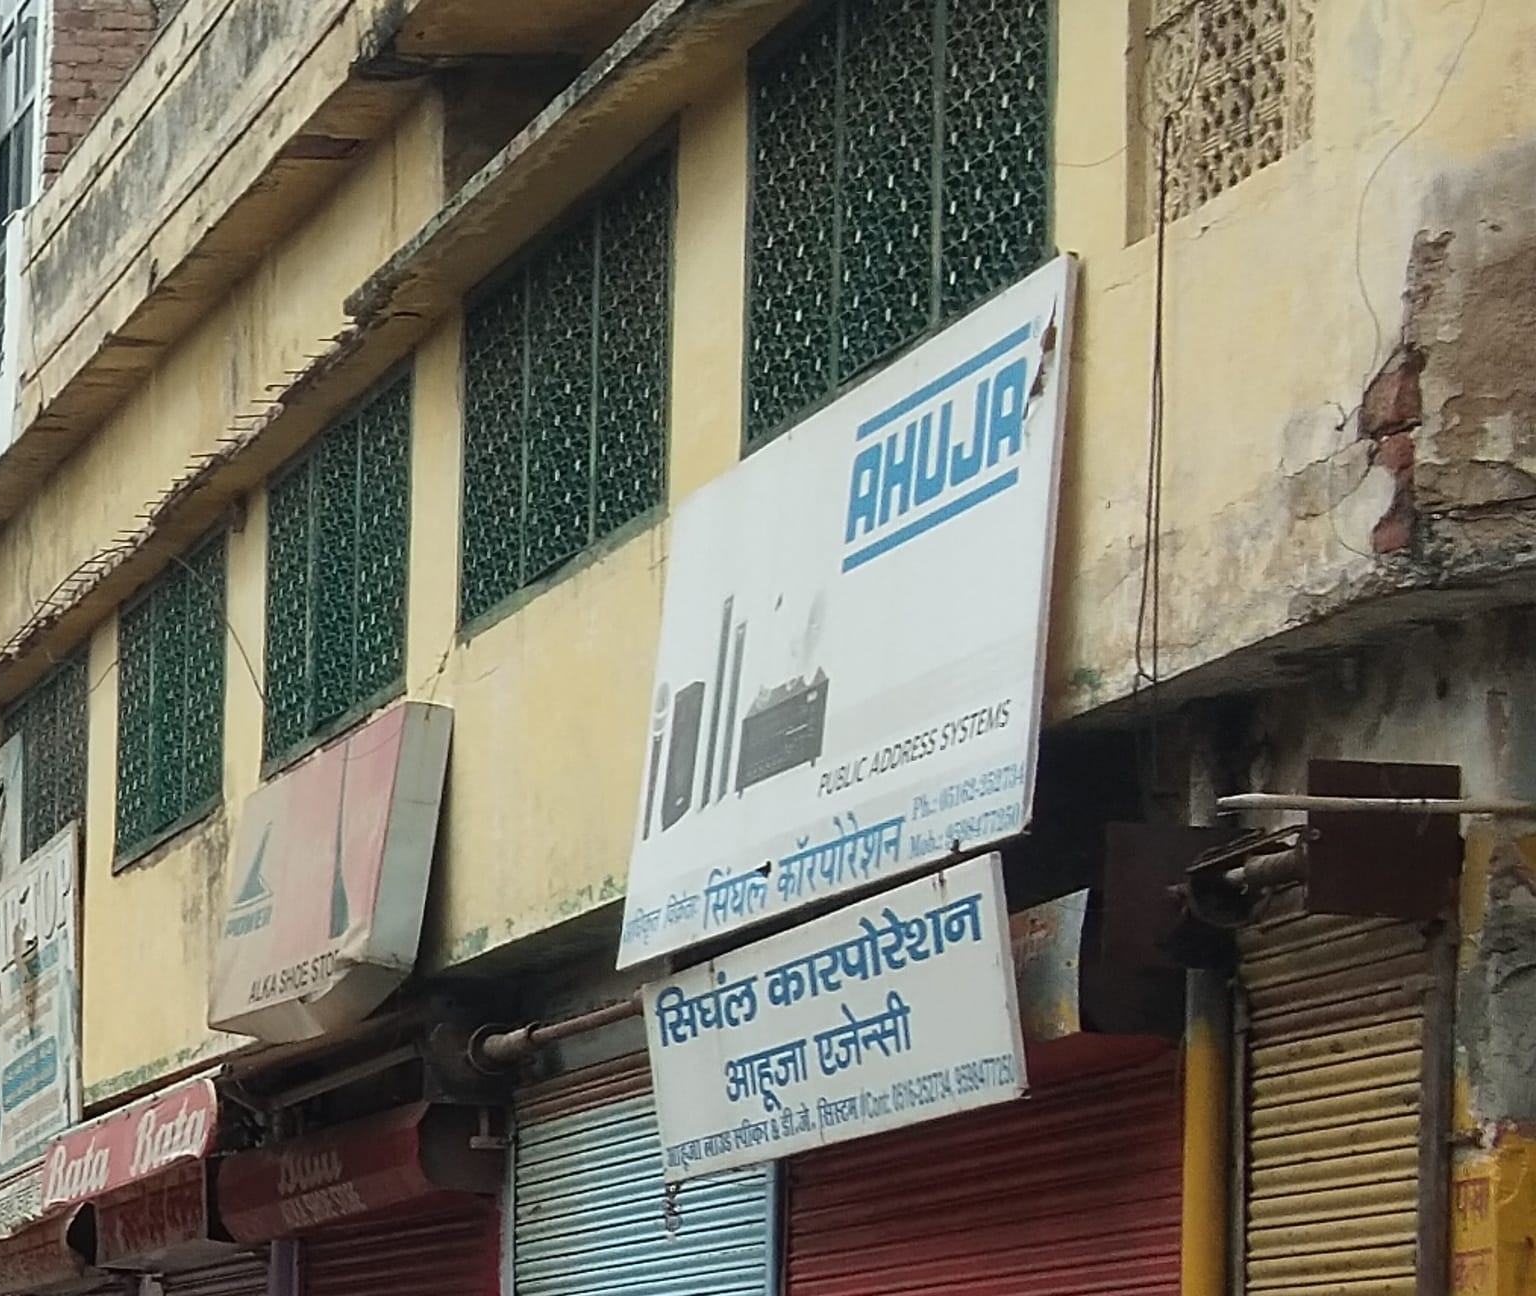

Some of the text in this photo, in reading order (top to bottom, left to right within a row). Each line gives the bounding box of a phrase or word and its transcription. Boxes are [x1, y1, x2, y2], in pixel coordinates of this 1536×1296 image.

[844, 356, 1027, 544] AHUJA
[817, 700, 1011, 798] PUBLIC ADDRESS SYSTEMS
[249, 970, 276, 1003] ALKA
[278, 960, 309, 992] SHOE
[764, 893, 983, 1007] कारपोरेशन
[725, 991, 912, 1113] आहूजा एजेन्सी
[44, 1098, 207, 1207] Bata Bata
